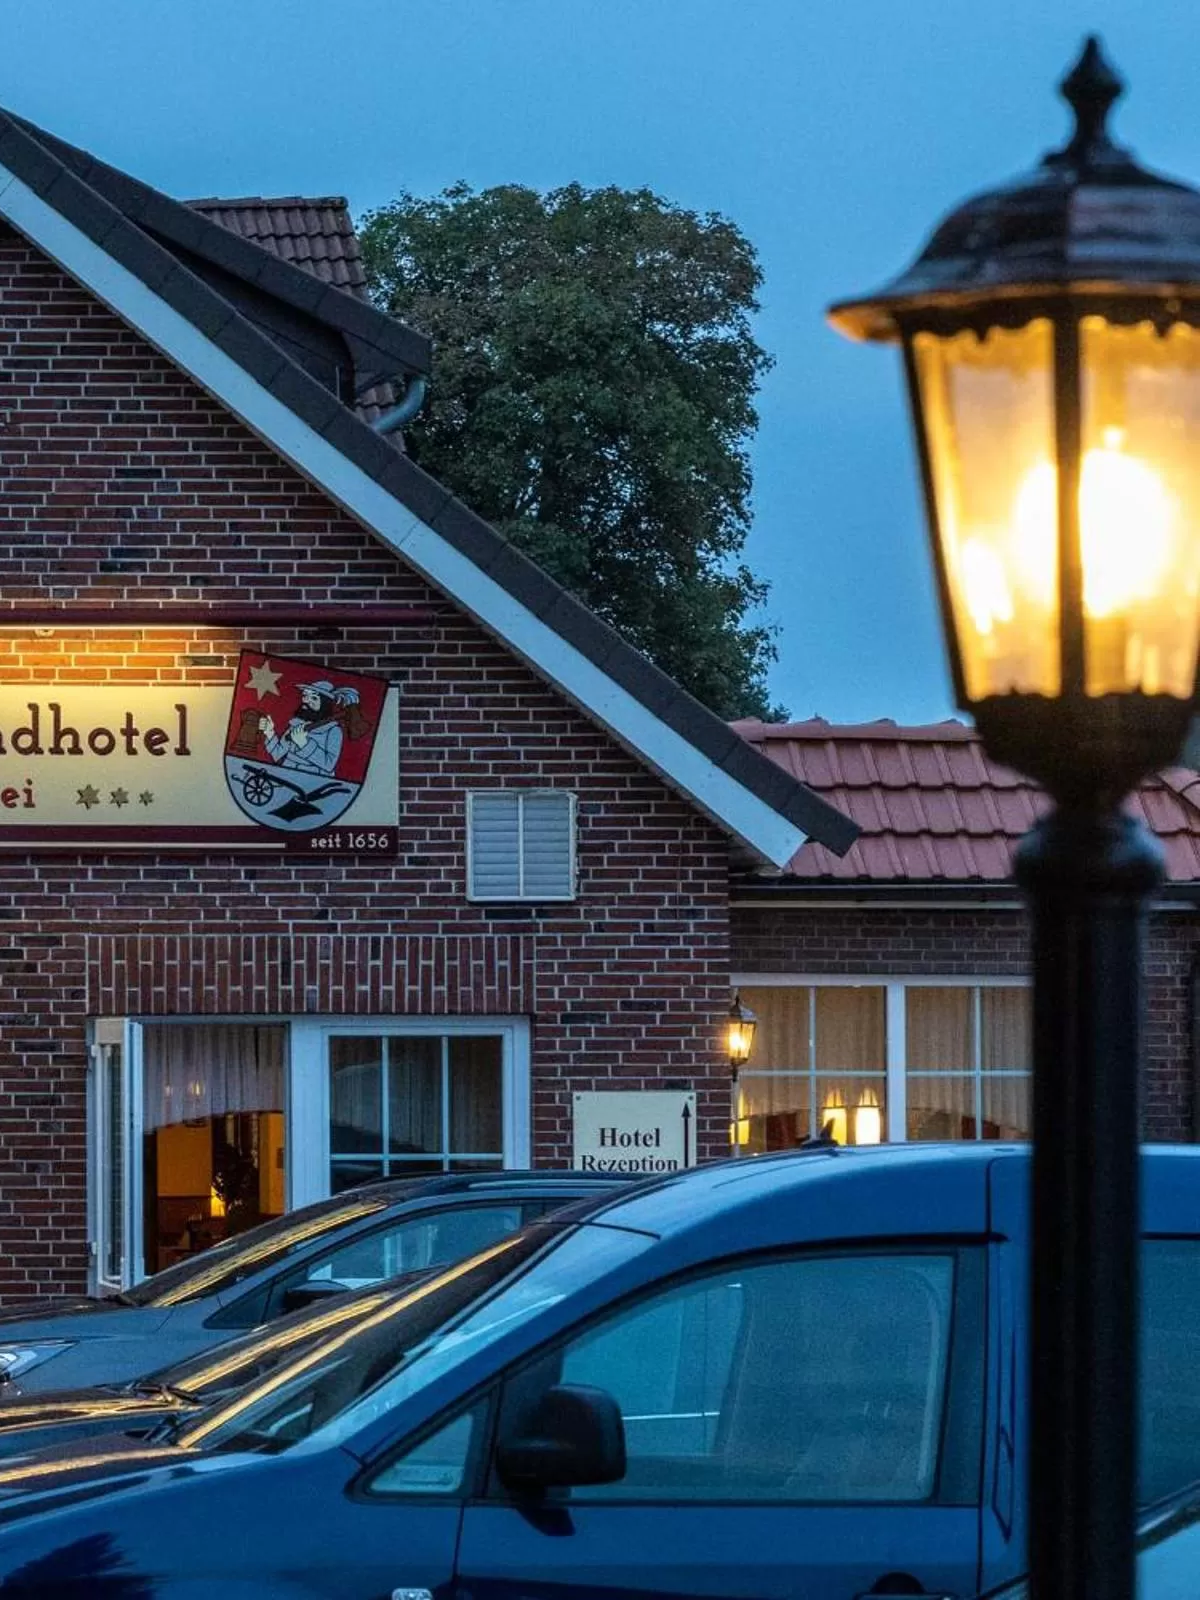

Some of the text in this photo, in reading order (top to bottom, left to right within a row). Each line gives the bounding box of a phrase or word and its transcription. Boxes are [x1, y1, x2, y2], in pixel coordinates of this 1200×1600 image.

[311, 832, 389, 849] seit 1656
[598, 1127, 661, 1149] Hotel
[580, 1154, 679, 1173] Rezeption
